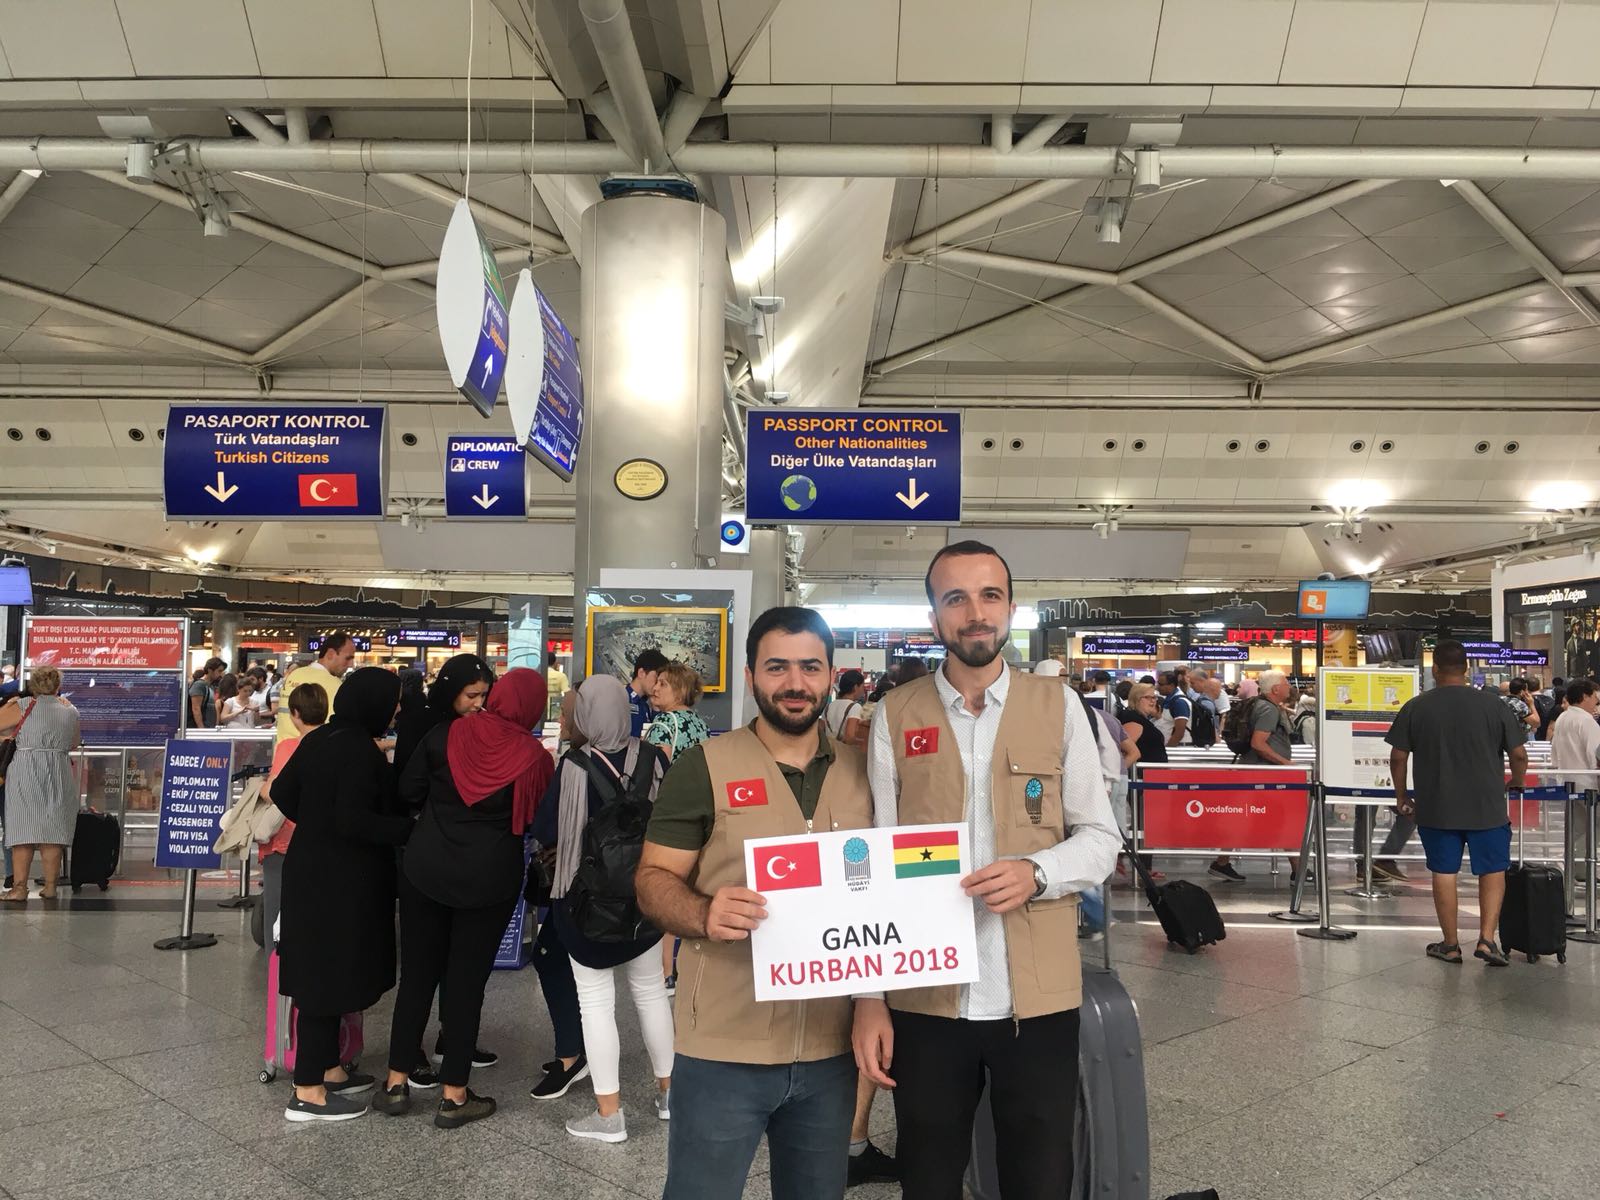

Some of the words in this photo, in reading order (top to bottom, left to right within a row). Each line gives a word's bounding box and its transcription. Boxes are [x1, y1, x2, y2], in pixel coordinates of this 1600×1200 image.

[184, 415, 280, 428] PASAPORT
[284, 415, 370, 428] KONTROL
[764, 418, 857, 432] PASSPORT
[862, 419, 948, 432] CONTROL
[214, 433, 246, 445] Türk
[251, 433, 339, 447] Vatandaşları
[795, 436, 834, 449] Other
[839, 437, 927, 449] Nationalities
[451, 442, 523, 452] DIPLOMATIC
[214, 451, 267, 464] Turkish
[272, 451, 329, 464] Citizens
[770, 454, 809, 470] Diğer
[813, 453, 844, 468] Ülke
[848, 455, 936, 471] Vatandaşları
[467, 460, 500, 470] CREW
[1521, 589, 1564, 606] Ermenegildo
[1564, 587, 1587, 603] Zegna
[151, 627, 178, 635] KATINDA
[1227, 629, 1276, 642] DUTY
[309, 641, 319, 650] 10
[387, 635, 398, 645] 12
[448, 636, 459, 646] 13
[361, 642, 370, 650] 11
[1084, 643, 1096, 653] 20
[1145, 644, 1156, 653] 21
[894, 648, 904, 657] 18
[1187, 651, 1198, 660] 22
[1238, 651, 1248, 660] 23
[1500, 648, 1512, 657] 25
[169, 755, 200, 768] SADECE
[206, 757, 228, 769] ONLY
[172, 775, 219, 787] DIPLOMATIK
[171, 787, 189, 799] EKİP
[194, 791, 219, 801] CREW
[171, 803, 197, 813] CEZALI
[198, 804, 224, 814] YOLCU
[1205, 805, 1243, 814] vodafone
[1250, 805, 1266, 814] Red
[168, 816, 213, 827] PASSENGER
[170, 830, 189, 840] WITH
[190, 831, 208, 841] VISA
[168, 843, 209, 855] VIOLATION
[822, 921, 902, 951] GANA
[770, 953, 883, 986] KURBAN
[893, 946, 959, 975] 2018
